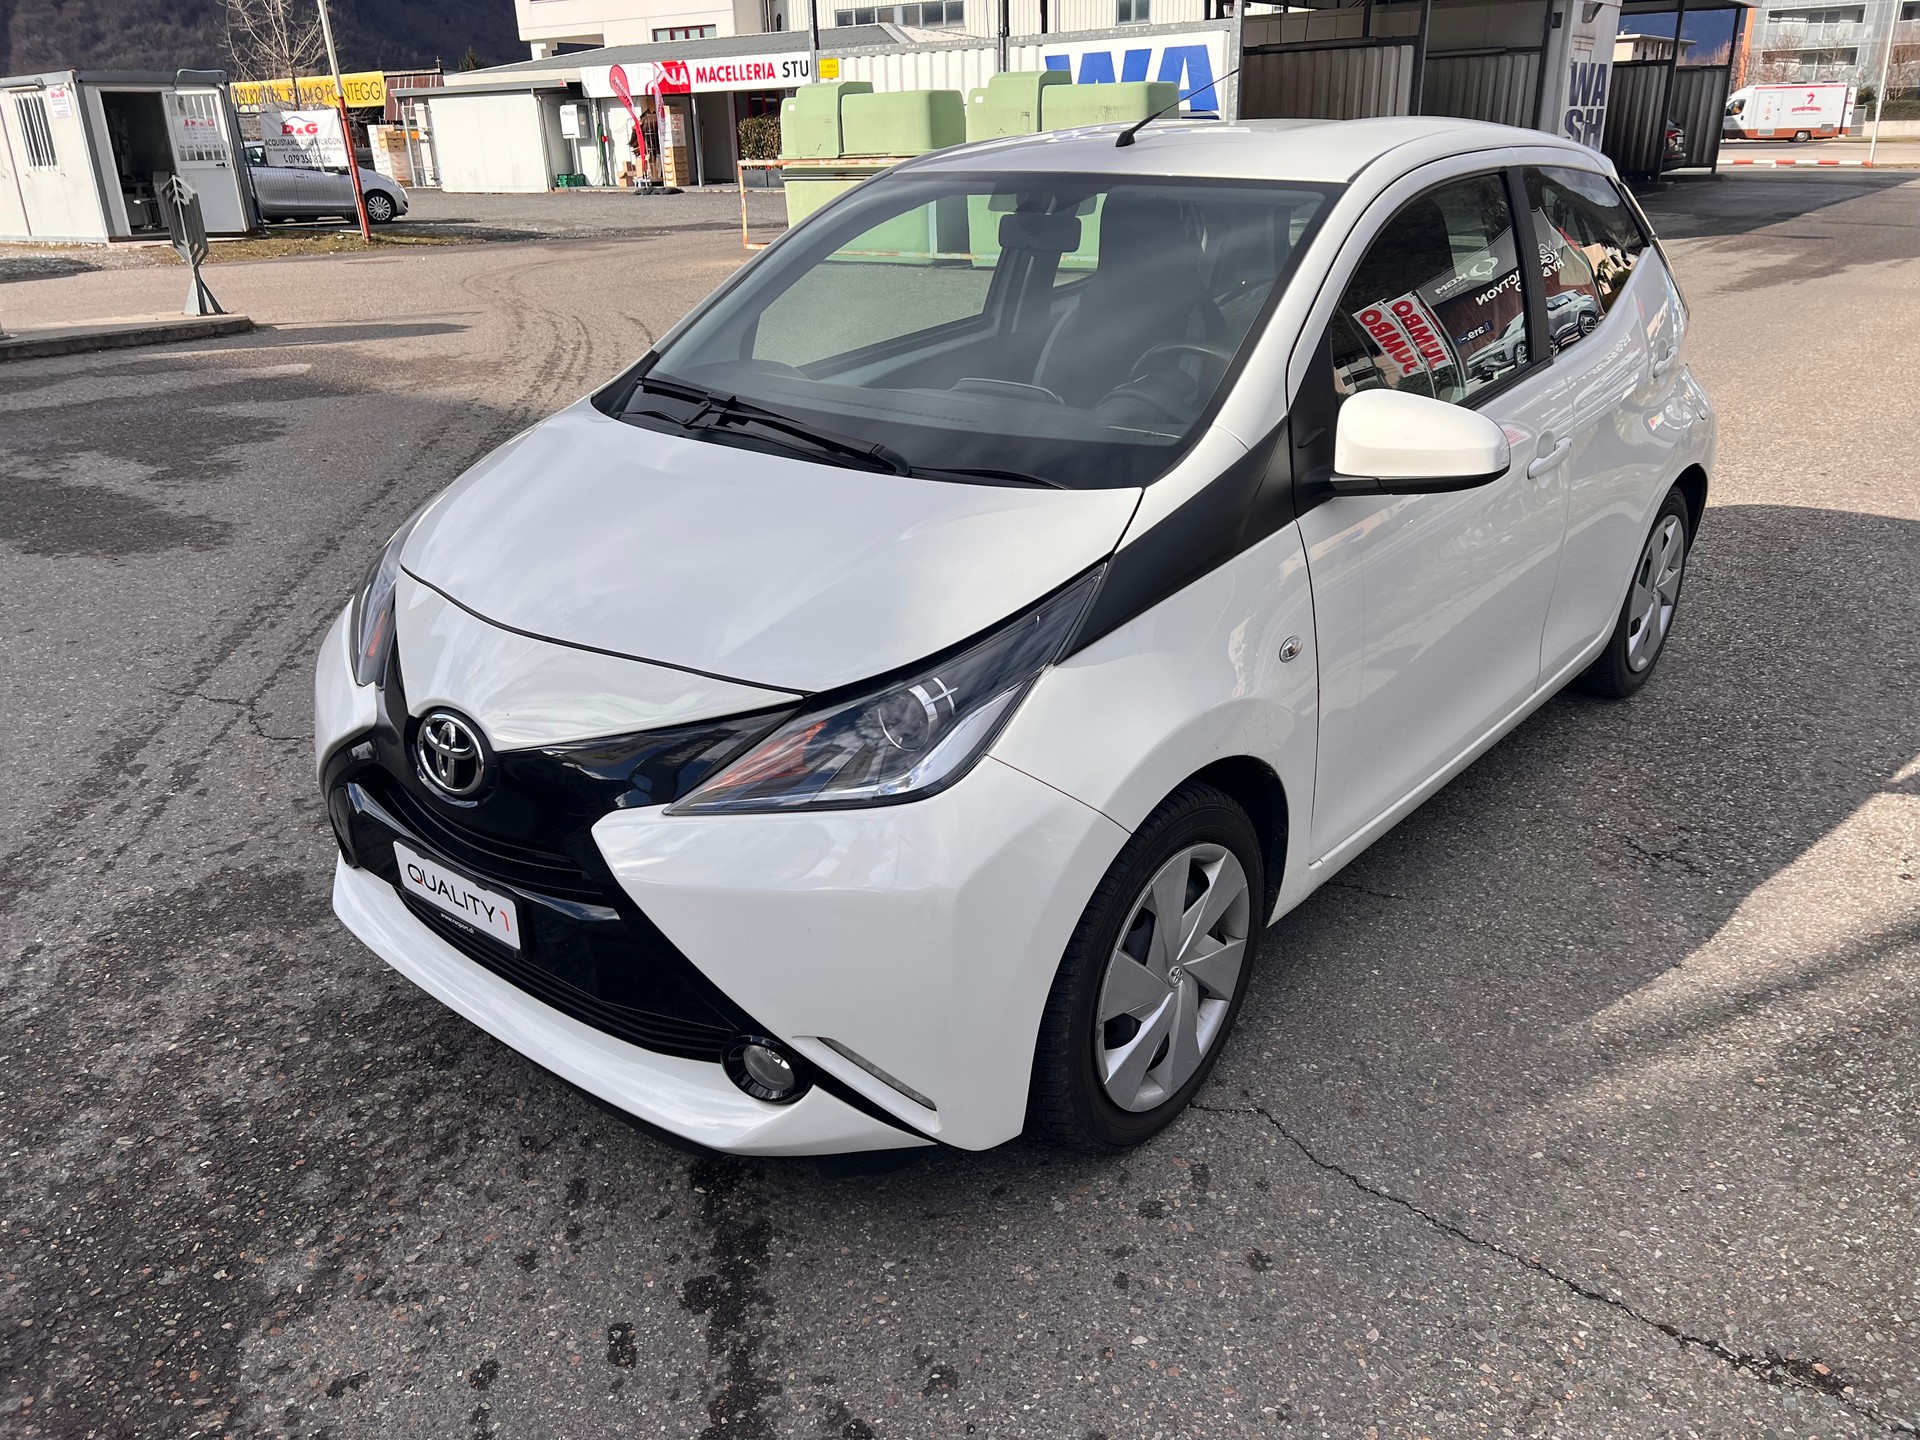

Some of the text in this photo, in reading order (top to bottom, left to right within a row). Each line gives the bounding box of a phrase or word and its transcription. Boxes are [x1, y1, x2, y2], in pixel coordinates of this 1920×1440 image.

[695, 62, 776, 84] MACELLERIA
[1569, 62, 1607, 107] WA
[282, 123, 318, 135] D&G
[288, 154, 299, 164] 079
